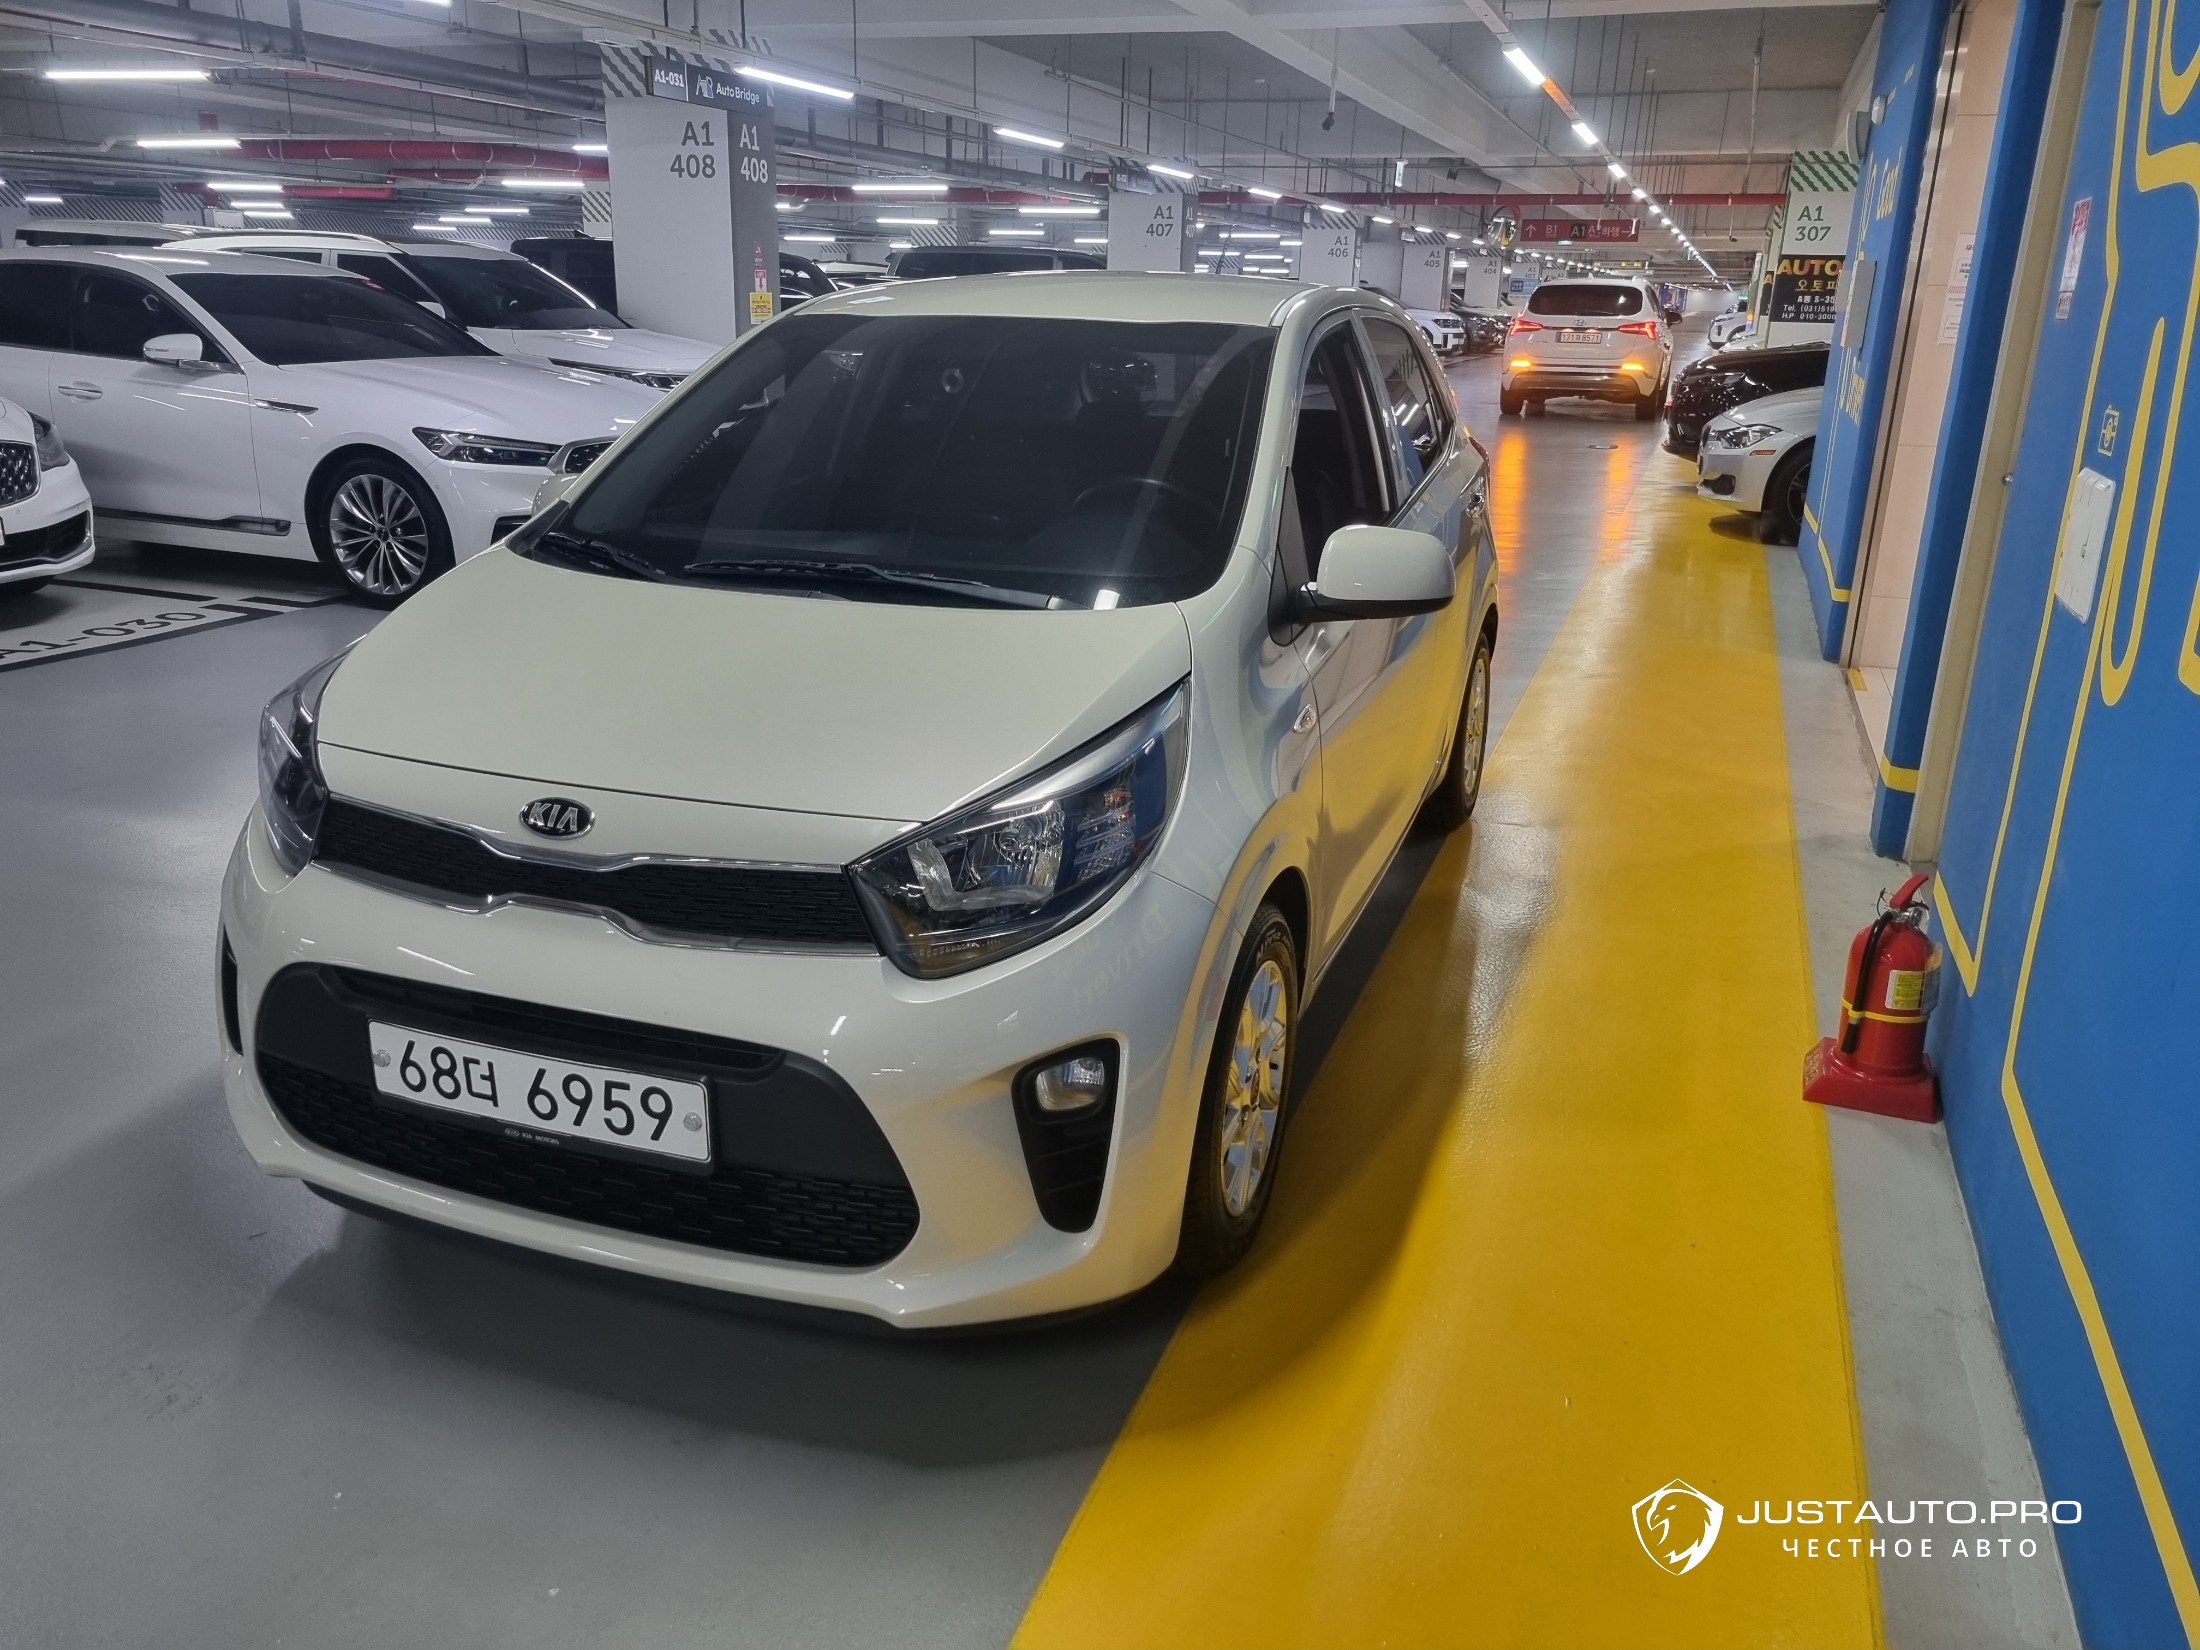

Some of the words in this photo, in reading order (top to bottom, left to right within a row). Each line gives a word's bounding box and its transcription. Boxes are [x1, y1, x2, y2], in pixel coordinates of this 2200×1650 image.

[654, 69, 685, 88] A1-031
[716, 82, 735, 98] Auto
[735, 86, 760, 105] Bridge
[681, 121, 715, 146] A1
[739, 123, 760, 151] A1
[670, 154, 716, 179] 408
[740, 157, 769, 184] 408
[1153, 205, 1174, 220] A1
[1798, 205, 1824, 222] A1
[1146, 223, 1174, 237] 407
[1570, 226, 1586, 237] A1
[1795, 226, 1831, 242] 307
[1334, 236, 1349, 246] A1
[1328, 248, 1349, 258] 406
[1429, 251, 1441, 259] A1
[1424, 260, 1440, 268] 405
[1776, 259, 1843, 276] AUTO
[528, 802, 579, 832] KIA
[399, 1040, 498, 1108] 68더
[526, 1067, 673, 1142] 6959
